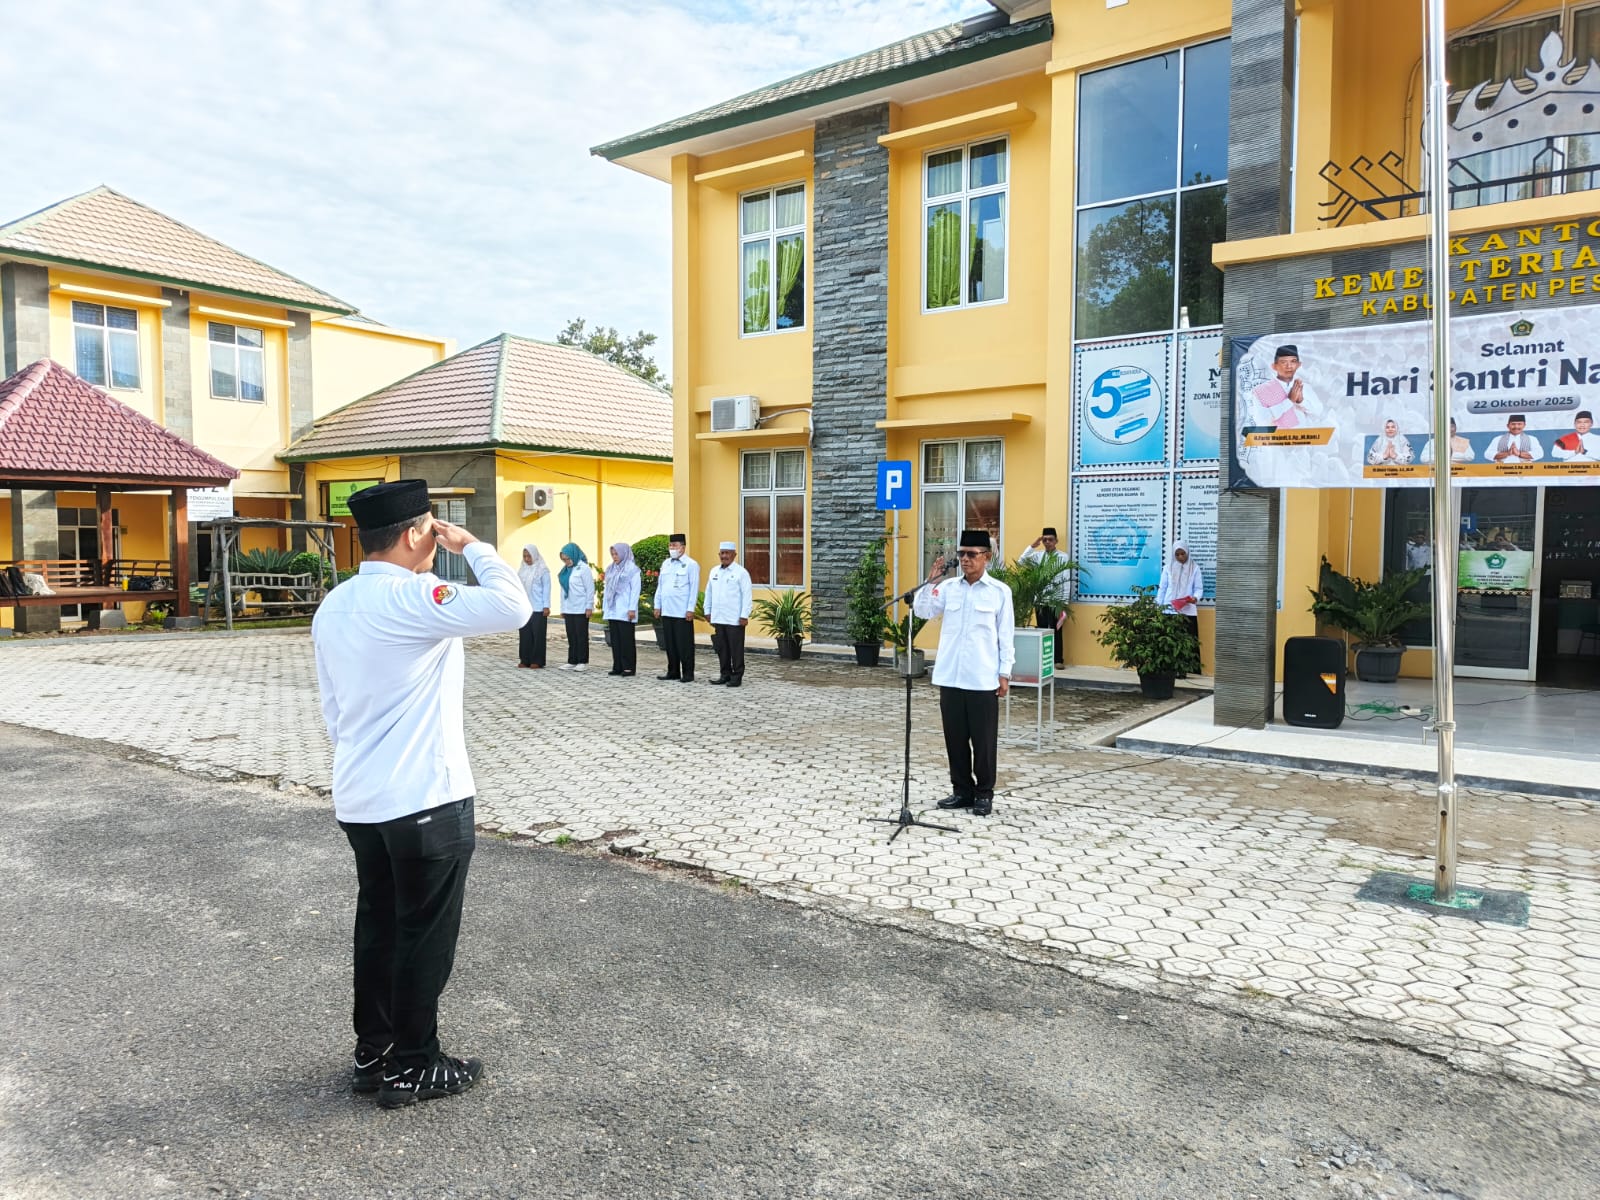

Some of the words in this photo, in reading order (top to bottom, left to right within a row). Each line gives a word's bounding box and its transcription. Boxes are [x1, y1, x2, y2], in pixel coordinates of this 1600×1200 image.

[1314, 245, 1600, 299] KEMETERIA
[1481, 339, 1565, 358] Selamat
[1090, 370, 1122, 419] 5
[1346, 366, 1420, 397] Hari
[1473, 400, 1487, 409] 22
[1490, 398, 1542, 409] Oktober
[1545, 396, 1574, 406] 2025
[886, 470, 902, 500] P
